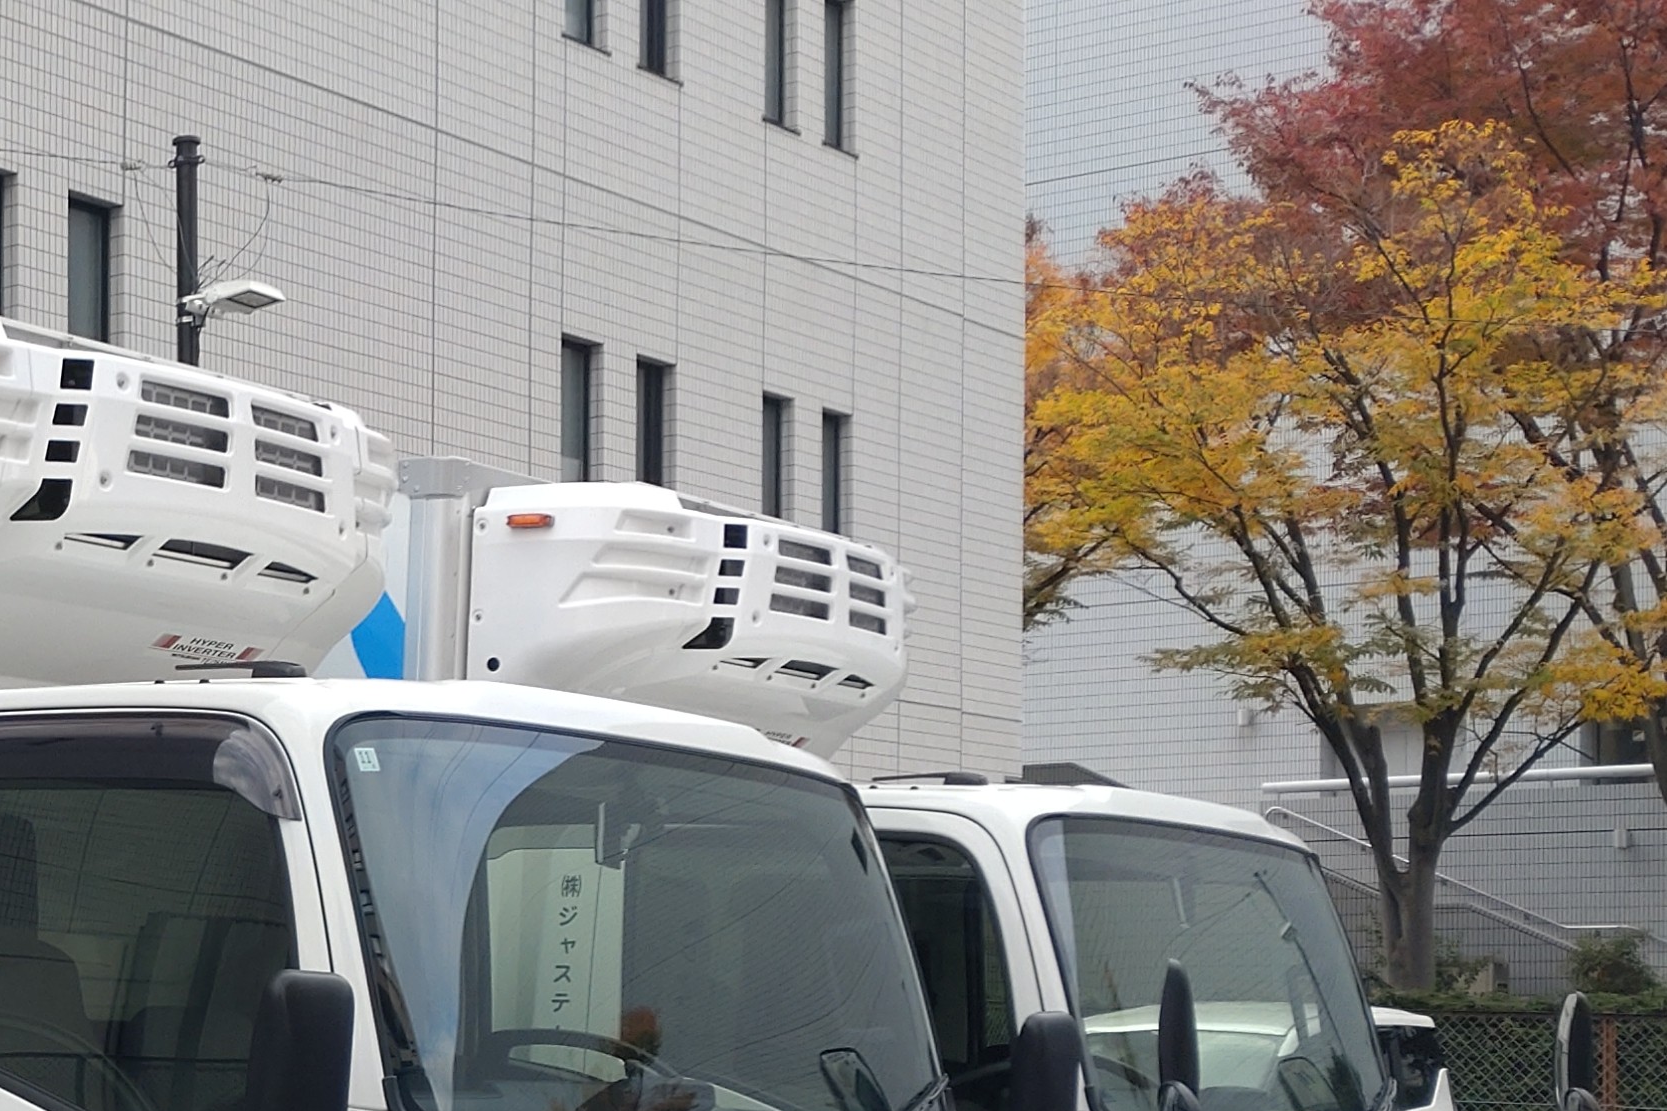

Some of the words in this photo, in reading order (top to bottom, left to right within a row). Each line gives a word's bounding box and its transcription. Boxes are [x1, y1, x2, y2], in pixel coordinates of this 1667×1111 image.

[172, 643, 237, 659] INVERTER
[189, 638, 234, 650] HYPER
[551, 875, 582, 1030] ㈱ジャステ
